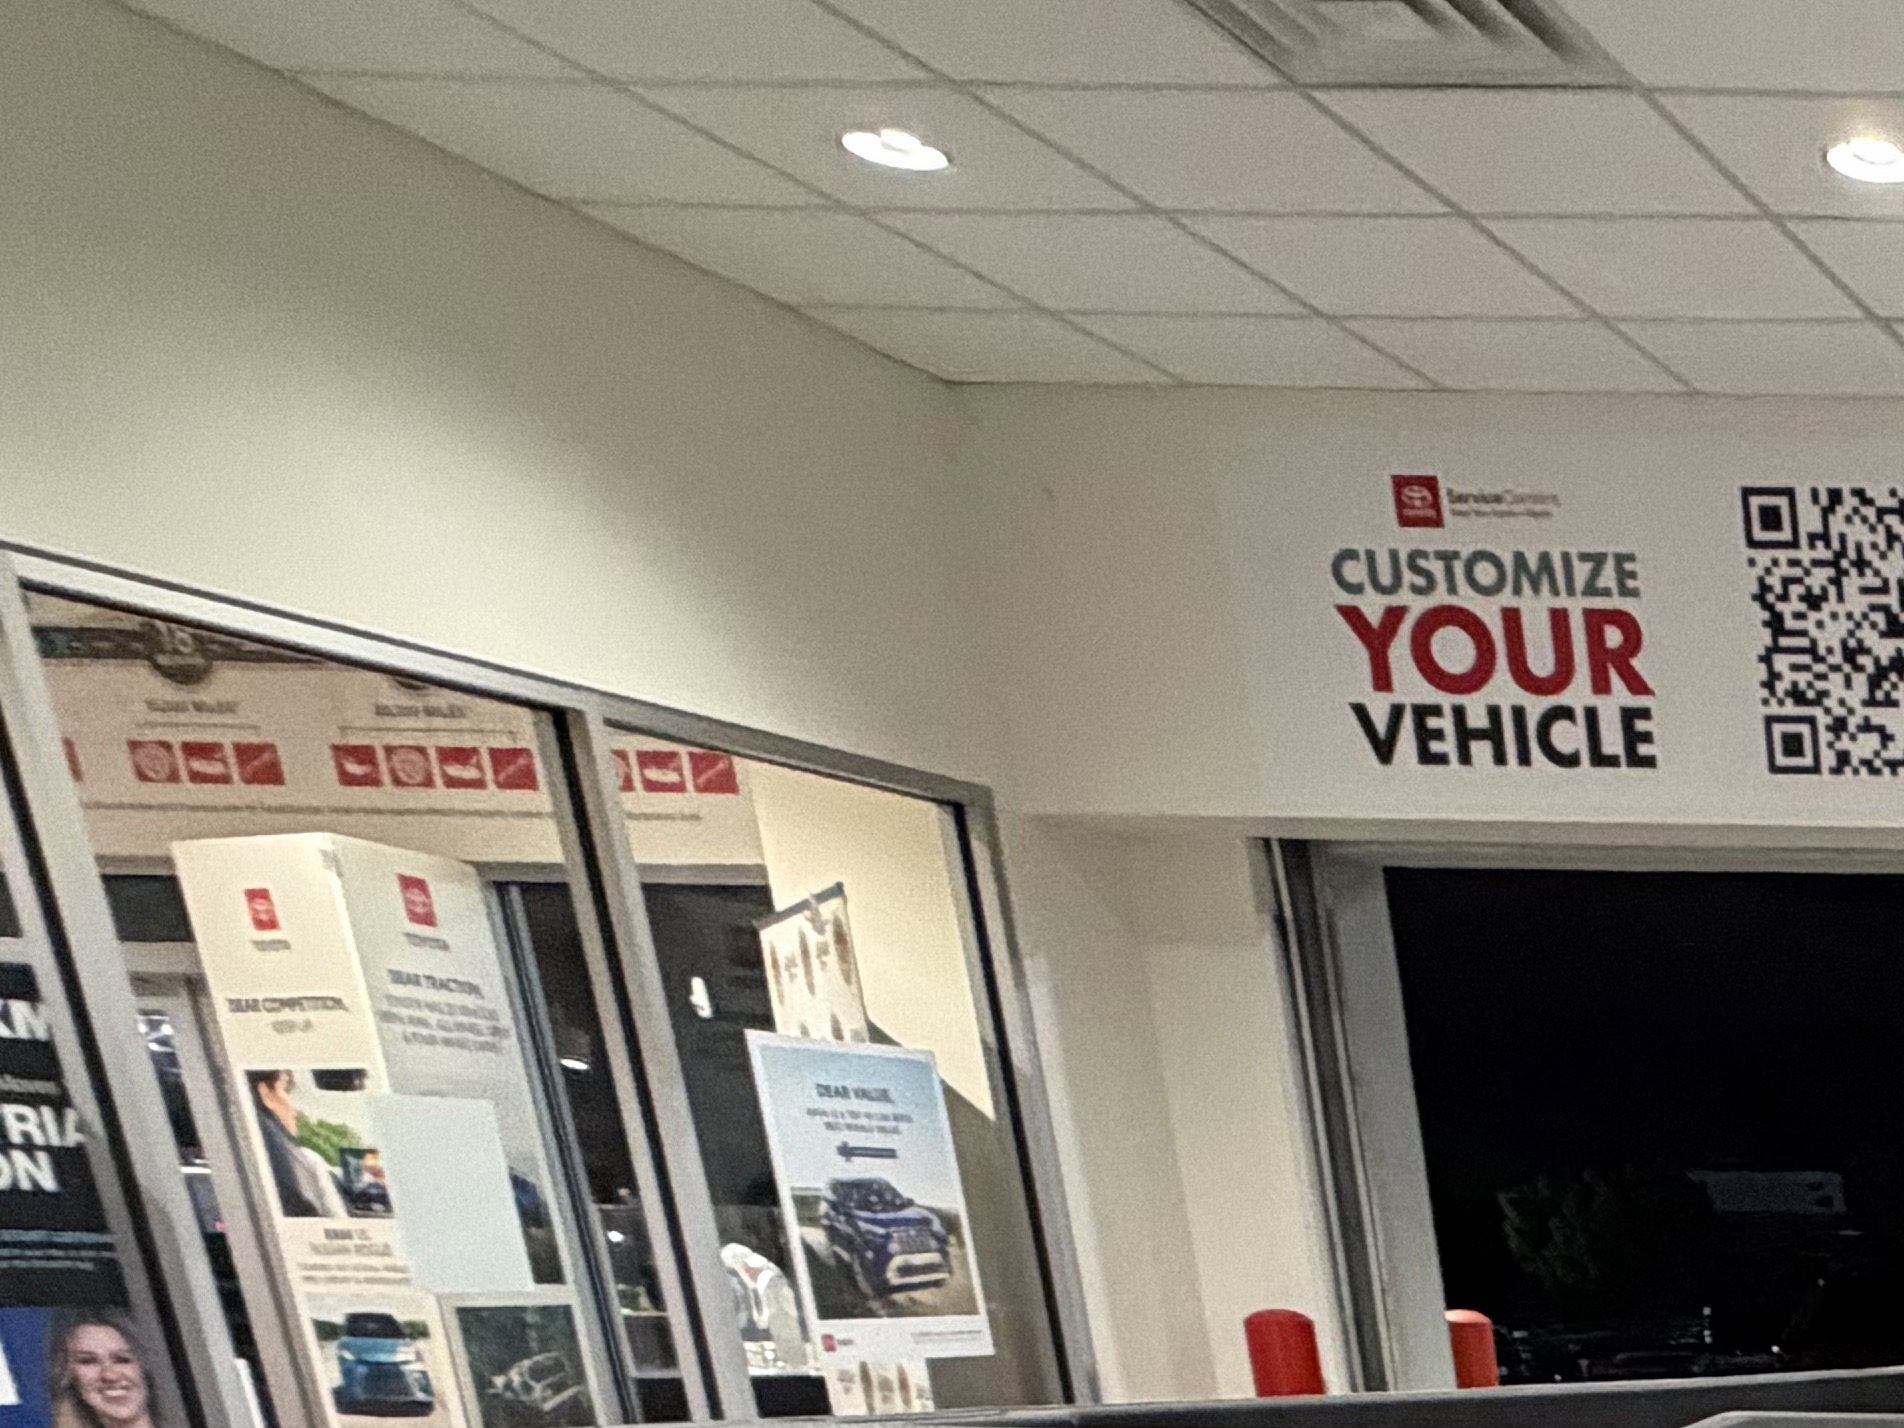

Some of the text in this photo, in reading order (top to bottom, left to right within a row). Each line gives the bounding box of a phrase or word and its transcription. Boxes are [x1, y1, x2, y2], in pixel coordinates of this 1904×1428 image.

[1330, 548, 1641, 598] CUSTOMIZE
[1334, 603, 1656, 697] YOUR
[1348, 702, 1658, 769] VEHICLE
